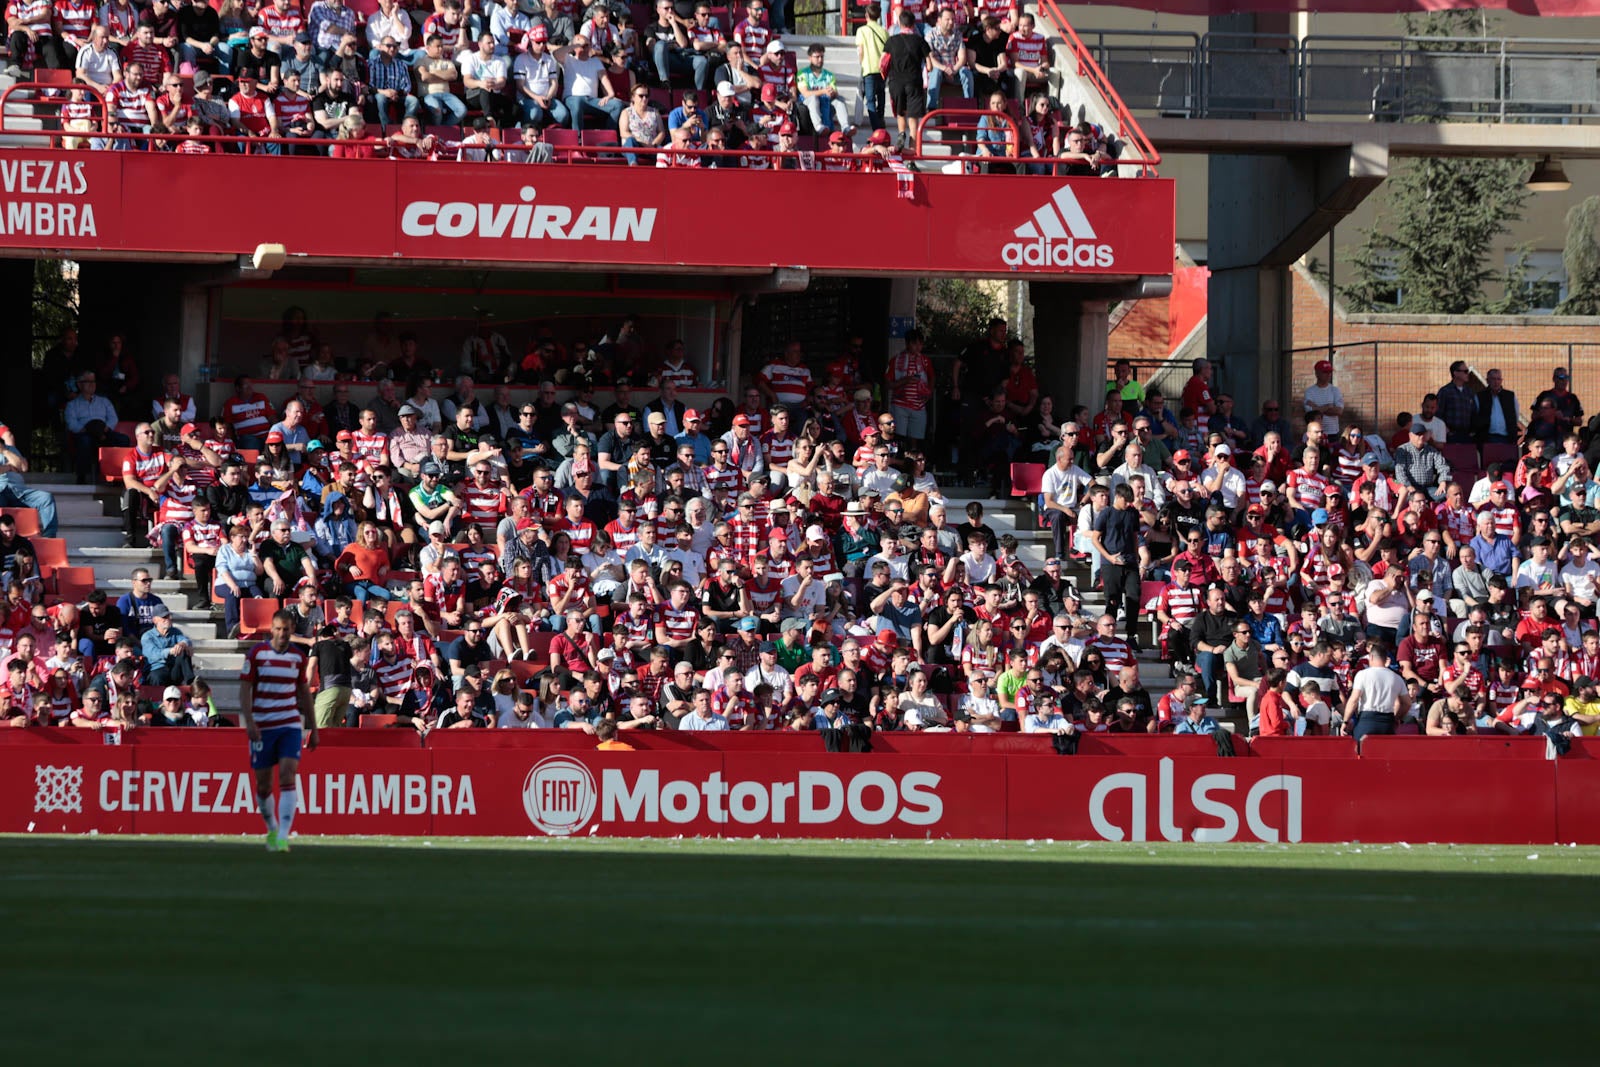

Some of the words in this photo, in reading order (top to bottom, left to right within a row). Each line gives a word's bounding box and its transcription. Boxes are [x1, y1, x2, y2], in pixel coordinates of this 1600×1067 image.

[1001, 237, 1114, 267] adidas
[99, 769, 262, 815] CERVEZA
[542, 780, 581, 812] FIAT
[601, 768, 943, 825] MotorDOS
[1089, 756, 1302, 842] alsa
